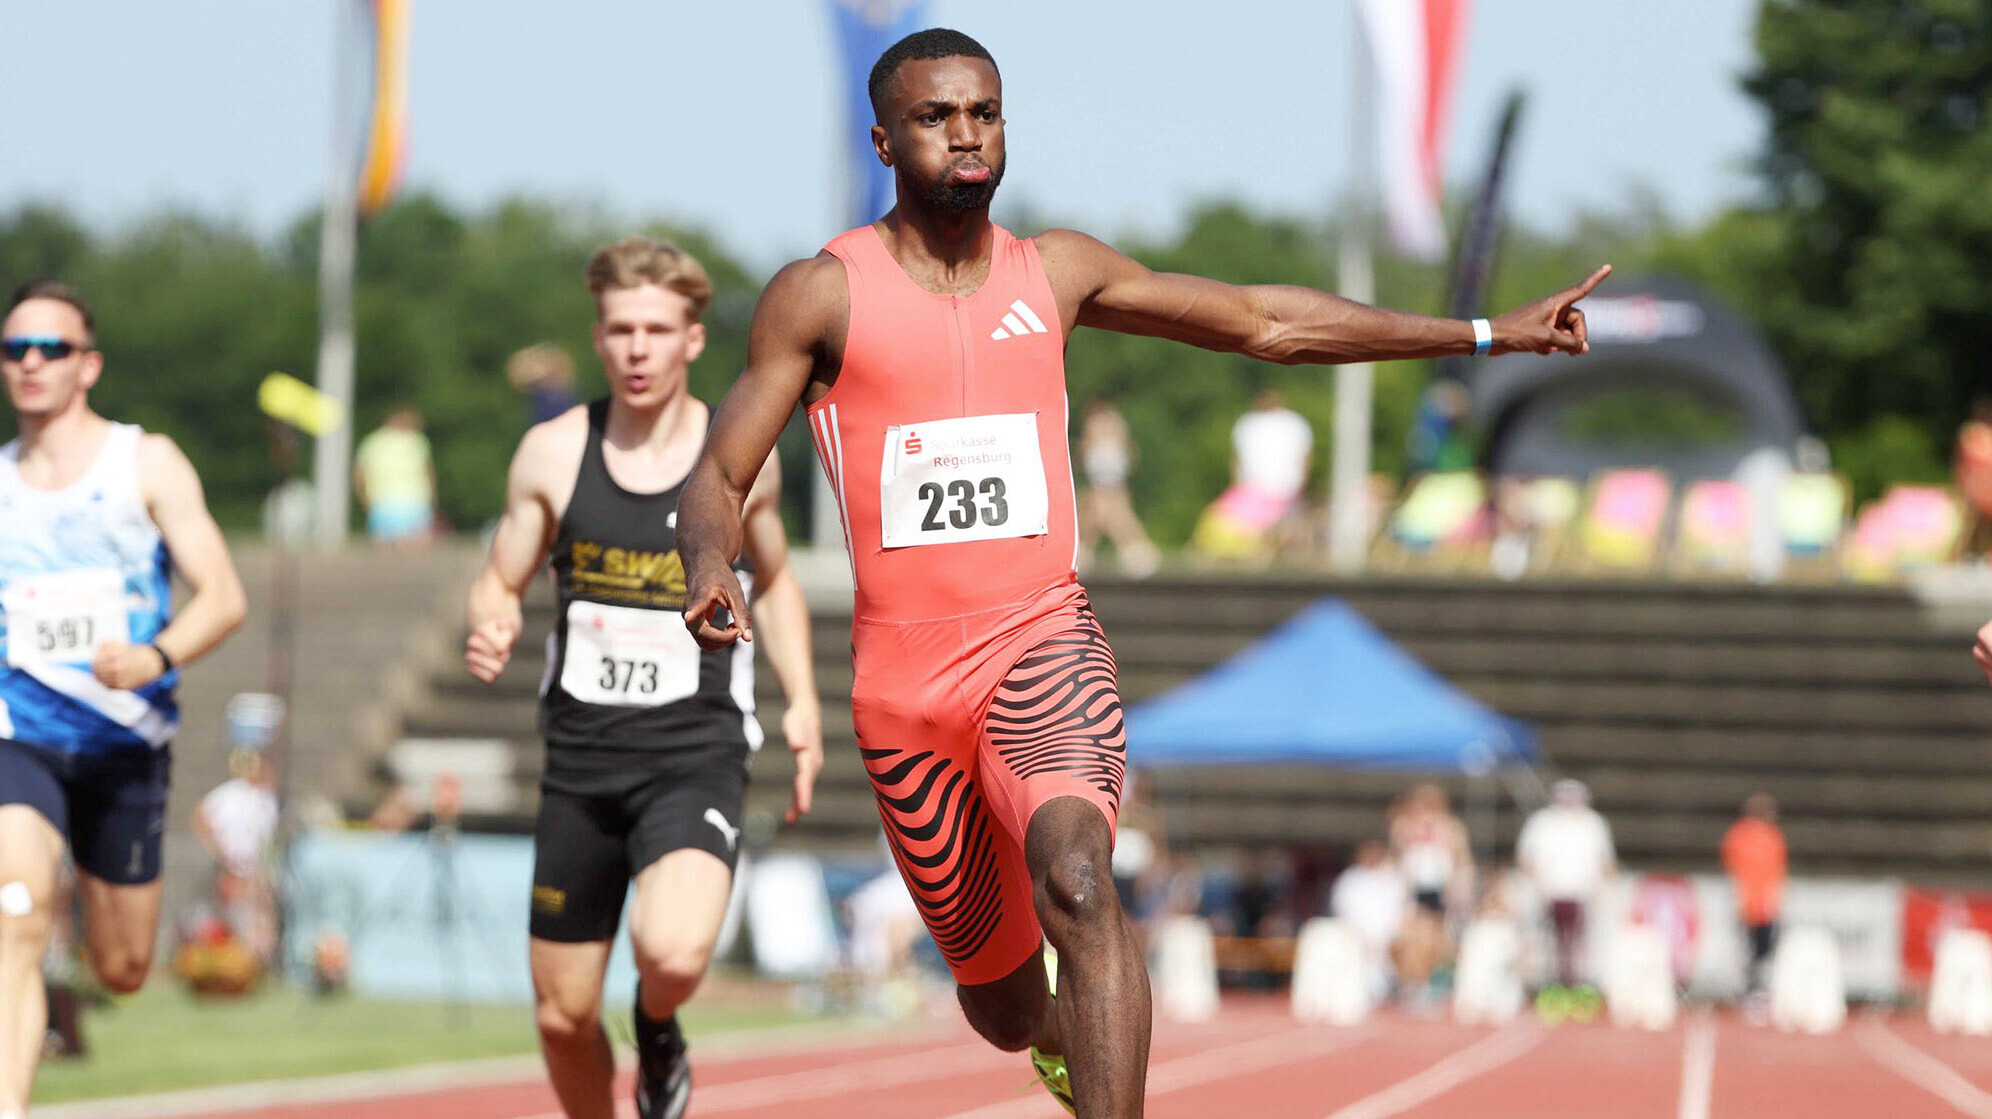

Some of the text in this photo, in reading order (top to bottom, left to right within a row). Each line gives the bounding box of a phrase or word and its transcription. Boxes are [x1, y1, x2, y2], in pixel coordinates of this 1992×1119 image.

[930, 436, 997, 451] Sprkasse
[934, 452, 1012, 468] Regensburg
[918, 477, 1009, 531] 233
[600, 656, 659, 694] 373
